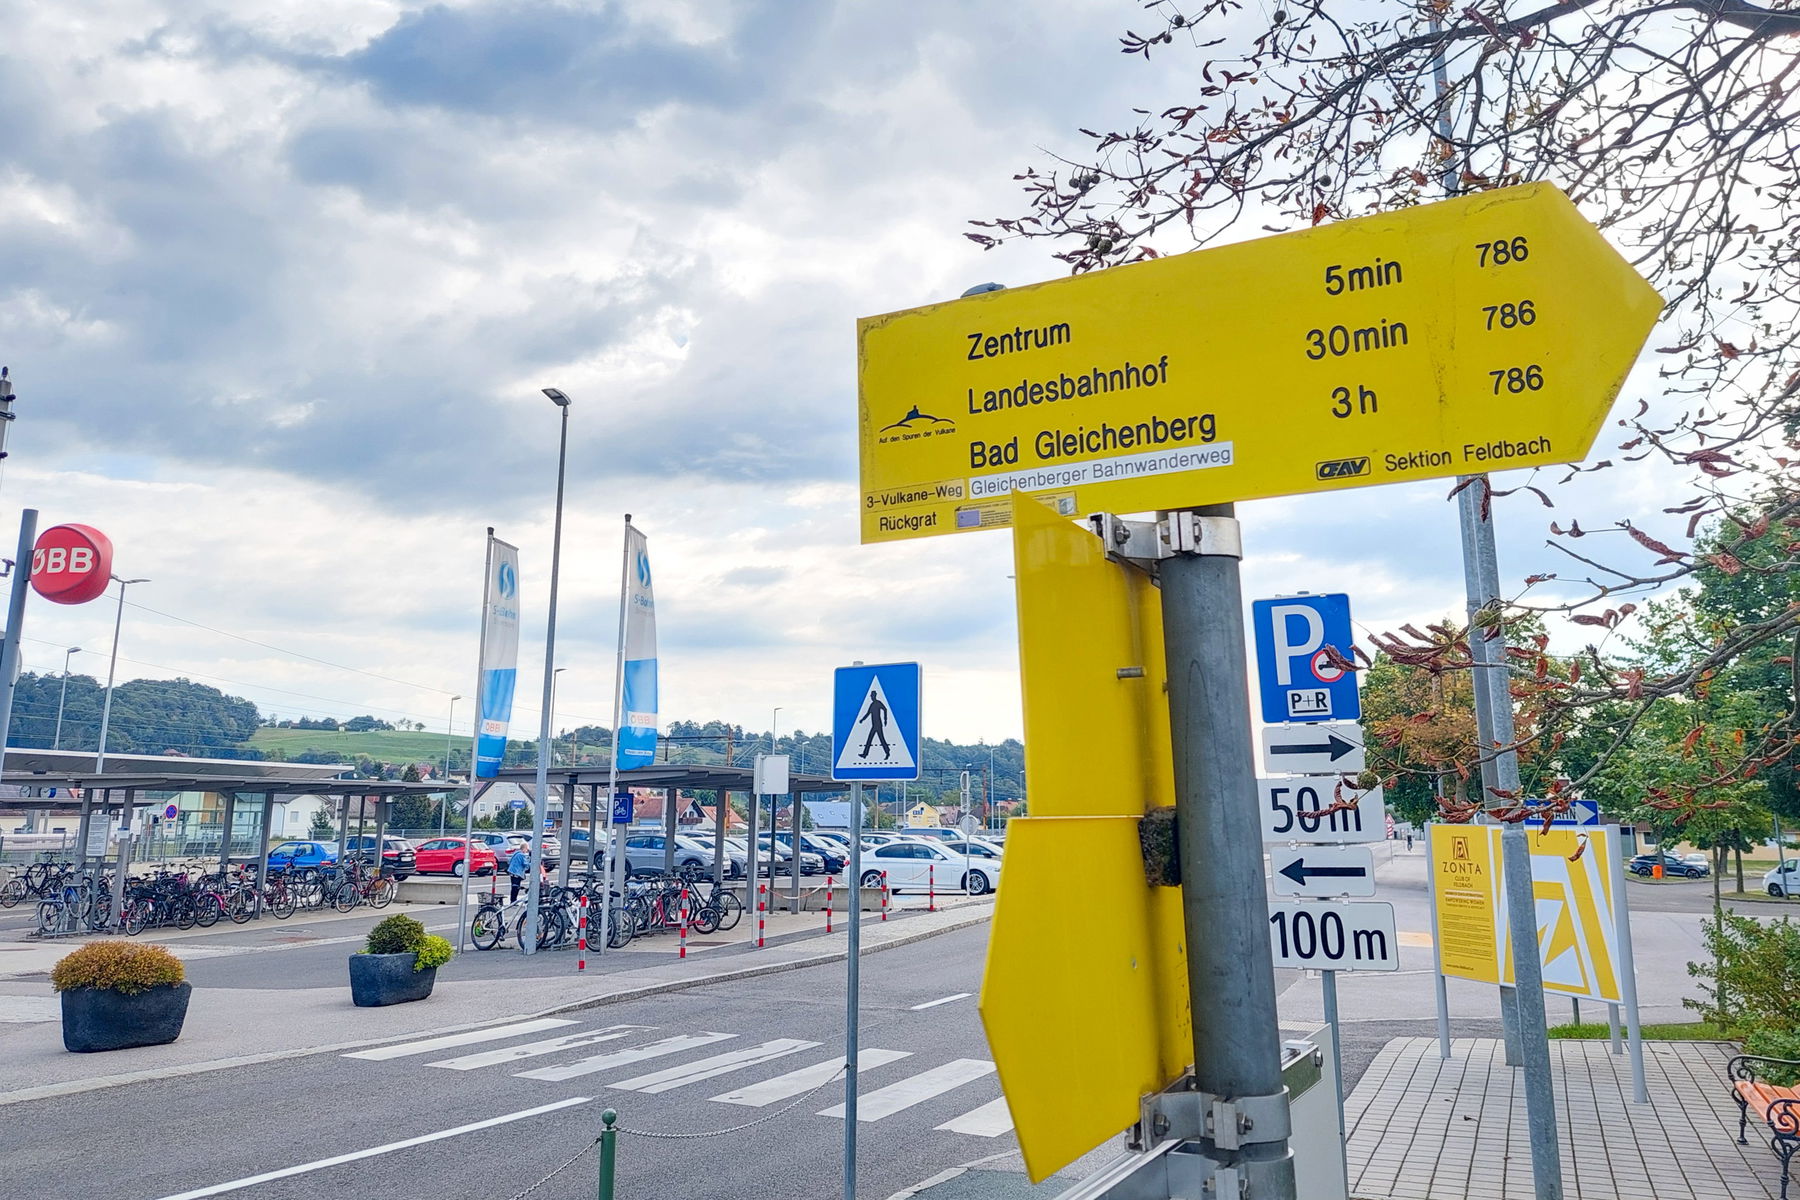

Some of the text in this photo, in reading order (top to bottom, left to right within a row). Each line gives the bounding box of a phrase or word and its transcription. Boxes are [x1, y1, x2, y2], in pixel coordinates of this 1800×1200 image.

[1475, 236, 1529, 268] 786
[1482, 300, 1537, 332] 786
[967, 322, 1071, 361] Zentrum
[968, 355, 1169, 414] Landesbahnhof
[1489, 364, 1544, 396] 786
[902, 433, 921, 441] Spuren
[970, 413, 1216, 469] Bad Gleichenberg
[1385, 444, 1452, 473] Sektion
[1464, 436, 1551, 463] Feldbach
[970, 447, 1231, 496] Gleichenberger Bahnwanderweg
[866, 484, 963, 509] 3-Vulkane-Weg
[879, 511, 937, 532] Rückgrat
[1271, 604, 1325, 686] P
[1291, 691, 1328, 709] P+R
[1443, 862, 1482, 875] ZONTA
